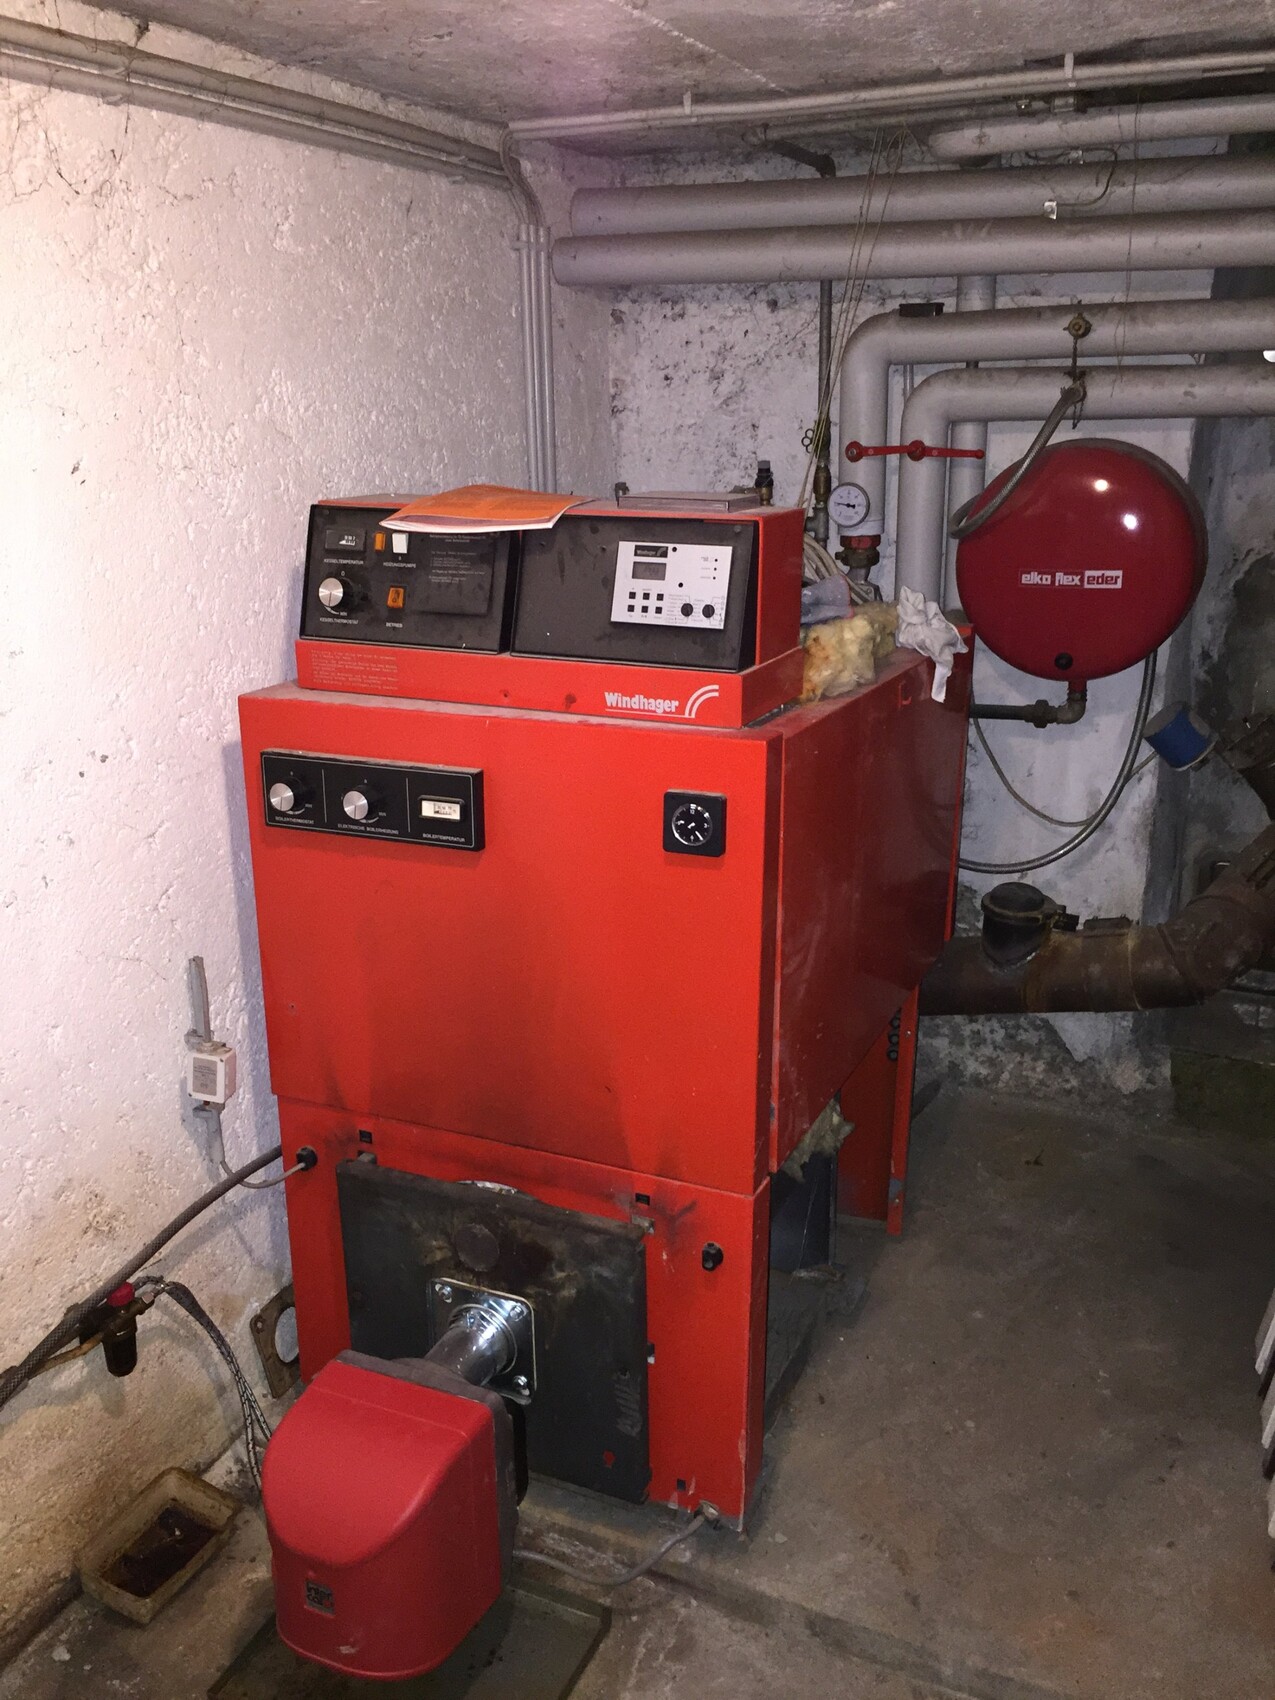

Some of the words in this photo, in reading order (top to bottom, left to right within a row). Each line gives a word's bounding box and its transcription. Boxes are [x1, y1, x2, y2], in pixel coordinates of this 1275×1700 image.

[1021, 571, 1051, 585] elko
[1055, 572, 1081, 586] flex
[1086, 573, 1120, 586] eder
[604, 692, 680, 714] Windhager
